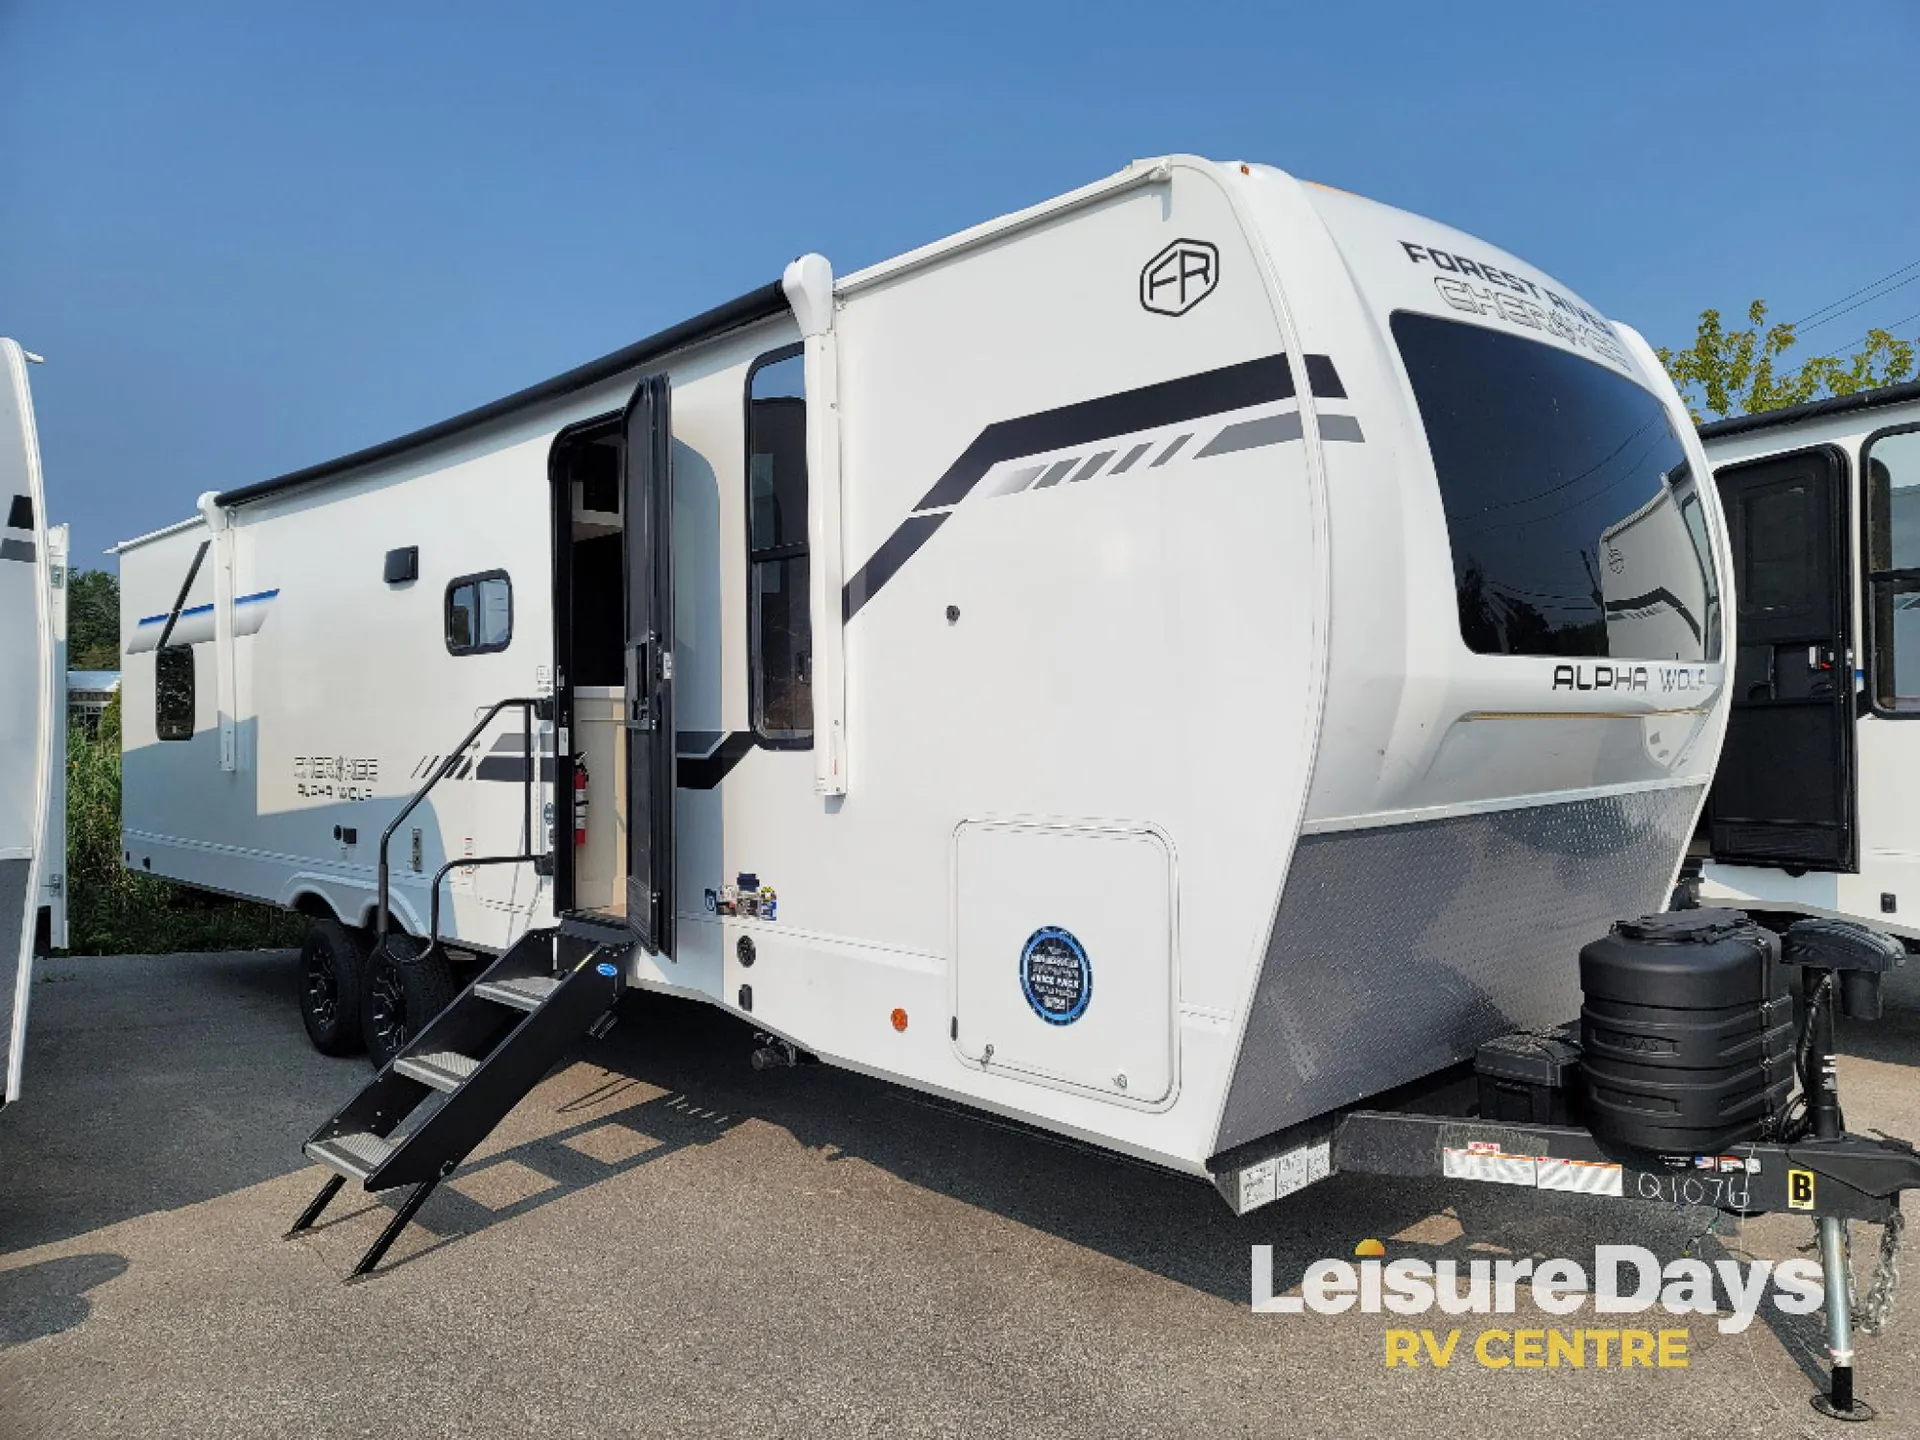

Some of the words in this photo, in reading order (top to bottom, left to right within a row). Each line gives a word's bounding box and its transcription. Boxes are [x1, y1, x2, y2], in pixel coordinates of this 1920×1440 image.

[1397, 239, 1542, 300] FOREST
[1552, 665, 1648, 691] ALPHA
[1792, 1173, 1812, 1202] B
